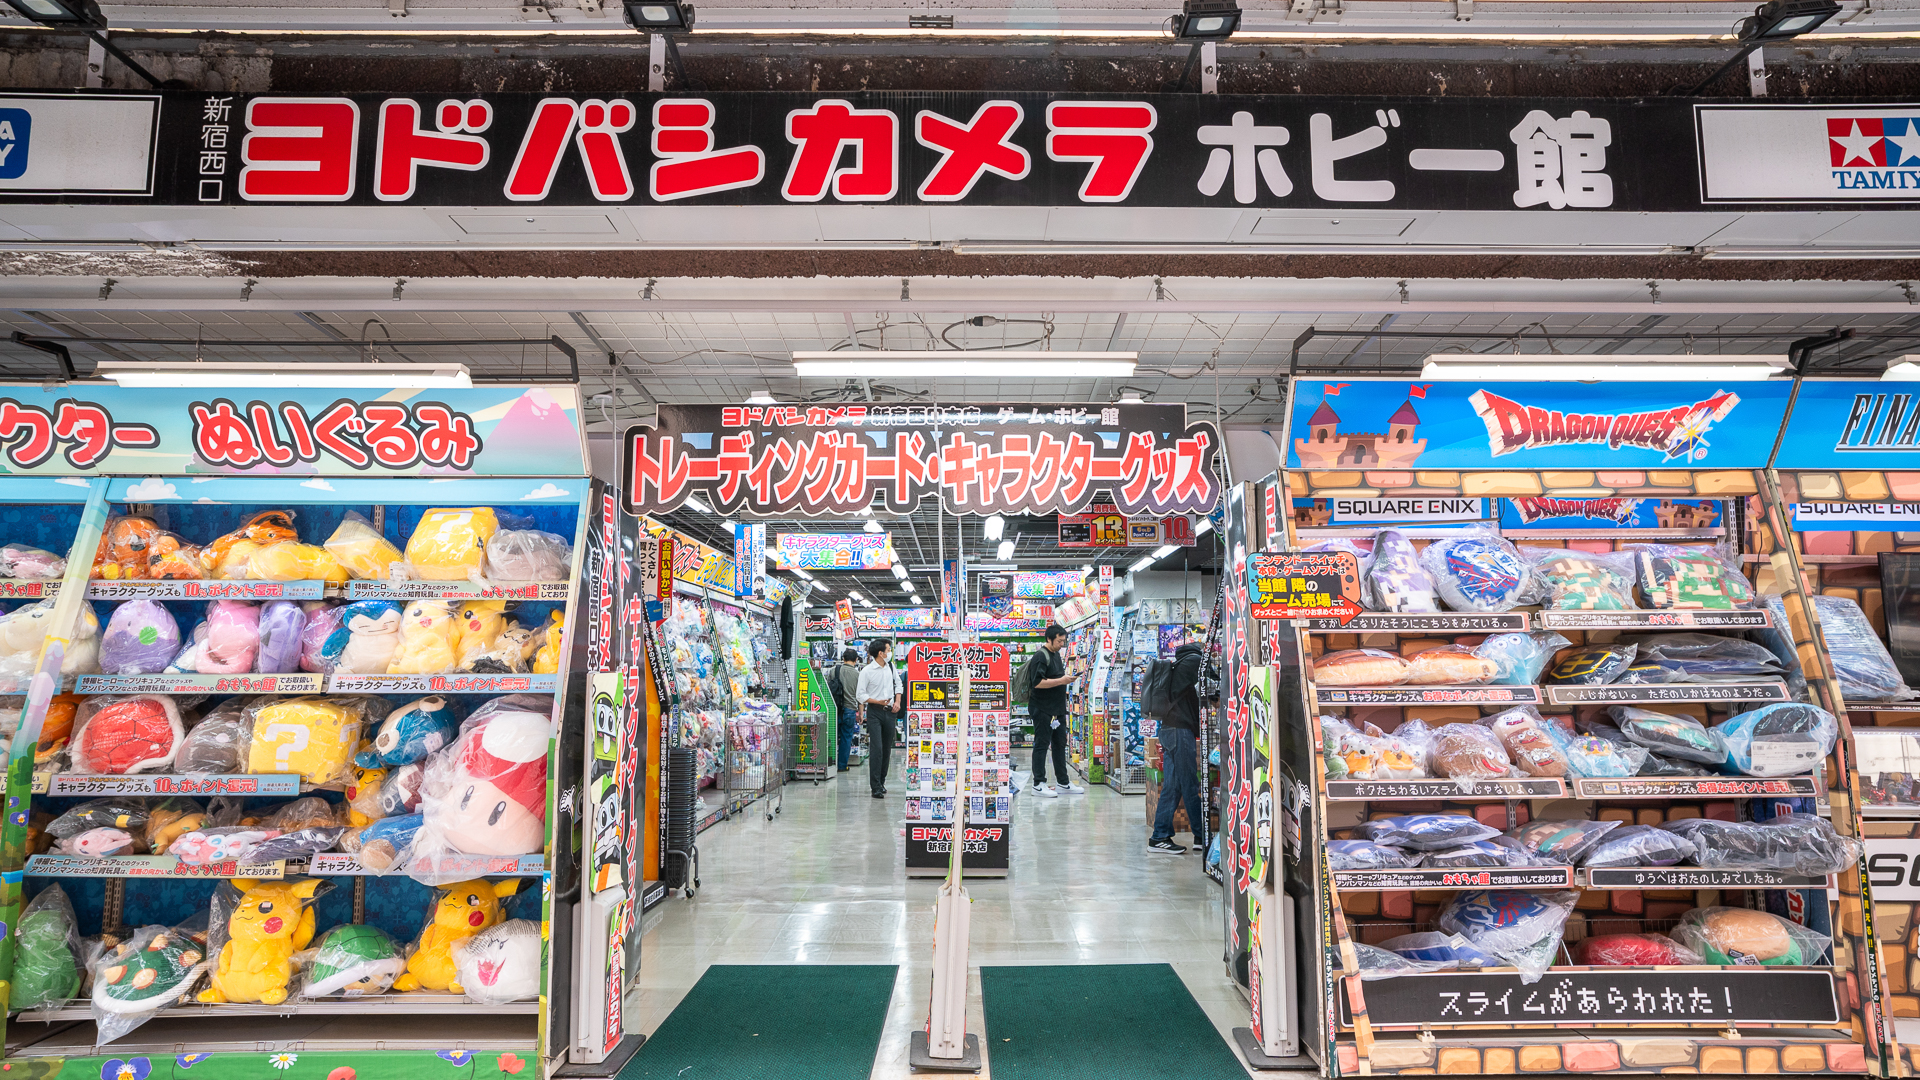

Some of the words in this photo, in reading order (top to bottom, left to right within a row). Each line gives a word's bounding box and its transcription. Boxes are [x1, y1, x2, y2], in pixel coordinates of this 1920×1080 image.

[199, 97, 231, 201] 新宿西口
[239, 97, 1157, 202] ヨドバシカメラ
[1197, 109, 1613, 209] ホビー館
[722, 406, 867, 426] ヨドバシカメラ
[998, 407, 1120, 425] ゲーム・ホビー館
[1469, 389, 1611, 457] DRAGON
[190, 399, 482, 469] ぬいぐるみ
[1337, 500, 1424, 516] SQUARE
[1428, 499, 1475, 514] ENIX
[783, 535, 886, 549] キャラクターグッズ
[647, 541, 657, 580] たくさん
[799, 549, 863, 569] 大集合!!
[1255, 555, 1346, 565] ニンテンドースイッチ
[660, 540, 672, 598] お買い物かご
[1257, 565, 1346, 576] 本体・ゲームソフトは
[90, 587, 181, 597] キャラクターグッズも
[1258, 577, 1287, 593] 当館
[1290, 577, 1319, 593] 隣の
[1259, 593, 1345, 608] ゲーム売場にて
[1103, 630, 1112, 649] 入口
[216, 677, 277, 692] おもちゃ館
[335, 680, 426, 691] キャラクターグッズも
[1349, 694, 1422, 702] キャラクターグッズも
[1423, 690, 1513, 702] お得なポイント還元!
[1567, 687, 1637, 700] へんじがない。
[1648, 686, 1772, 699] ただのしかばねのようだ。
[57, 782, 151, 793] キャラクターグッズも
[1621, 785, 1697, 795] キャラクターグッズも
[1697, 781, 1789, 793] お得なポイント還元!
[912, 828, 1002, 841] ヨドバカメラ
[1635, 870, 1783, 884] ゆうべはおたのしみでしたね。
[1868, 853, 1920, 887] S
[1442, 872, 1490, 885] おもちゃ館
[1491, 874, 1565, 884] でお取扱いしております
[1439, 978, 1733, 1016] スライムがあらわれた!
